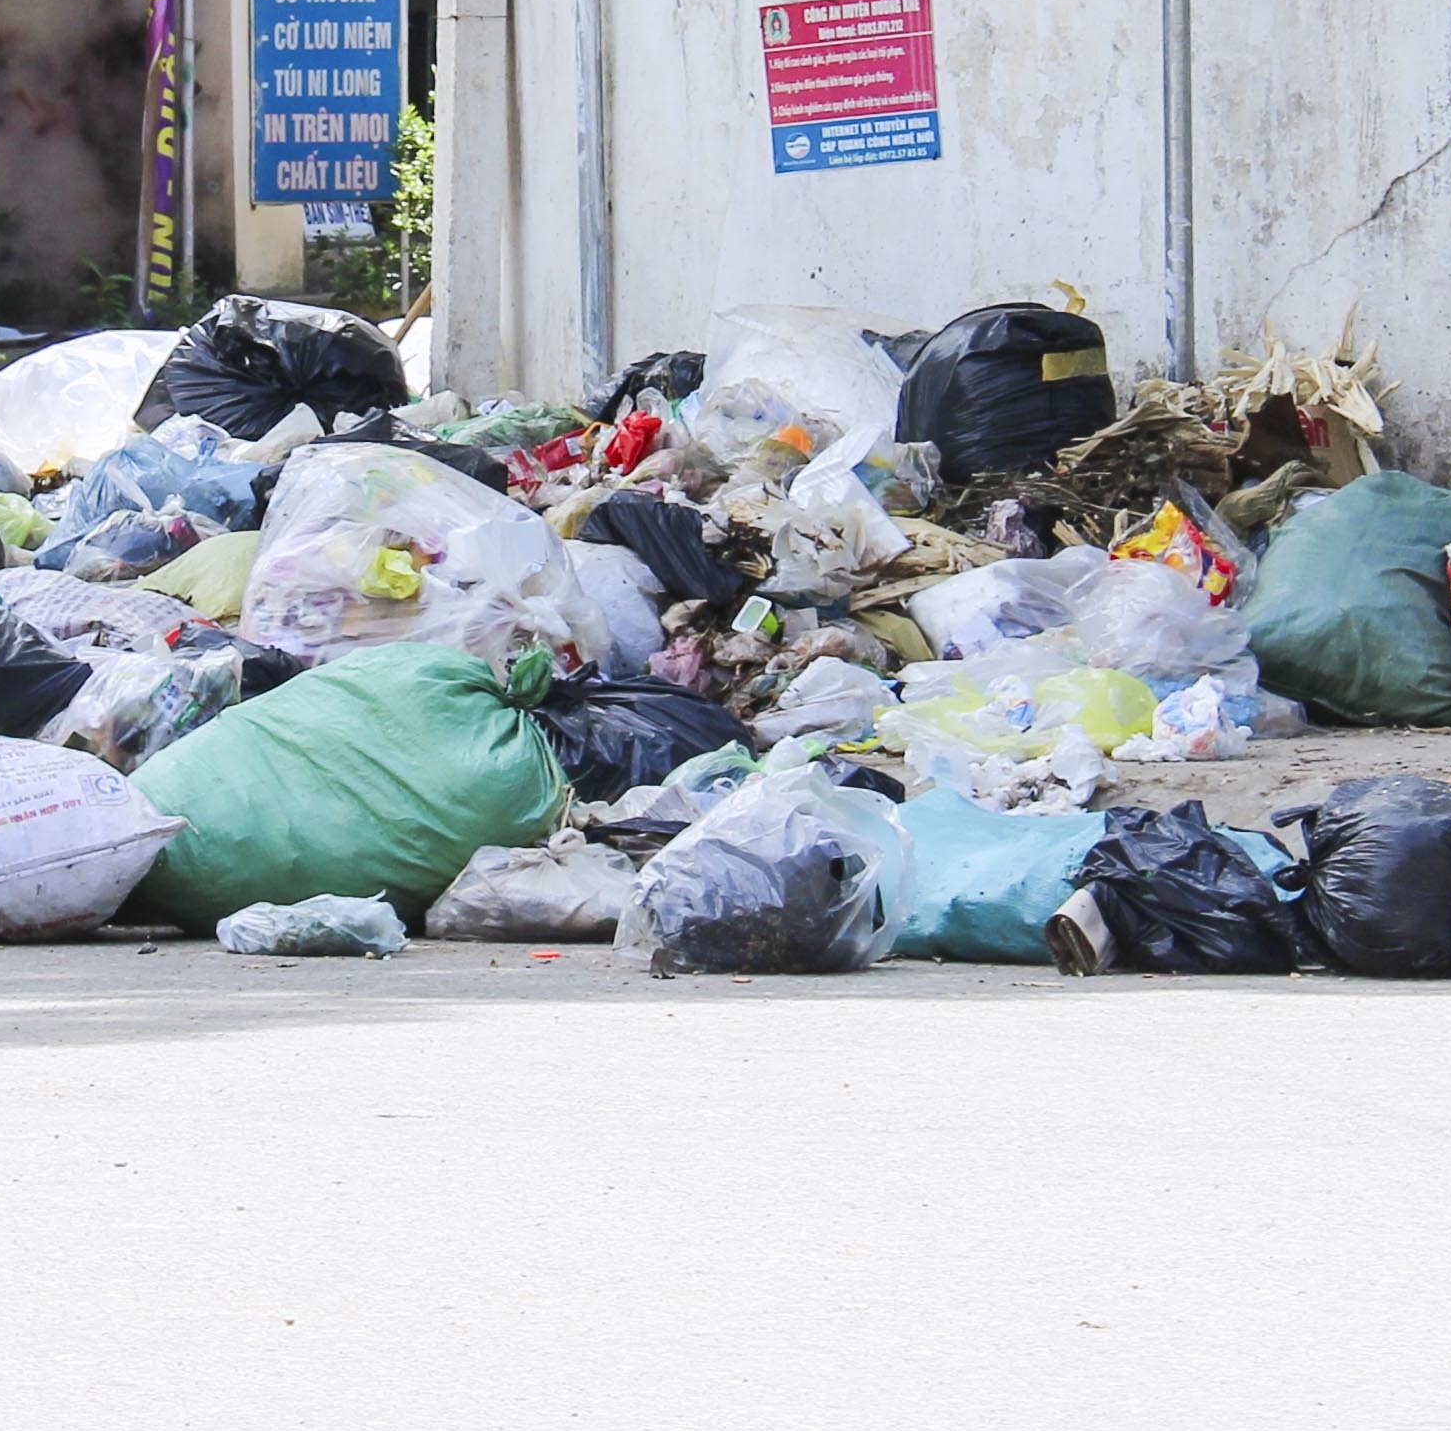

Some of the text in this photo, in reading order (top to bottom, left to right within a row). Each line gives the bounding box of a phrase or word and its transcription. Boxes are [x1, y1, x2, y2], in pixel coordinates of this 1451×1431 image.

[274, 15, 392, 56] CỜ LƯU NIỆM
[274, 65, 381, 97] TÚI NI LONG
[264, 110, 390, 148] IN TRÊN MỌI
[276, 149, 330, 191] CHẤT
